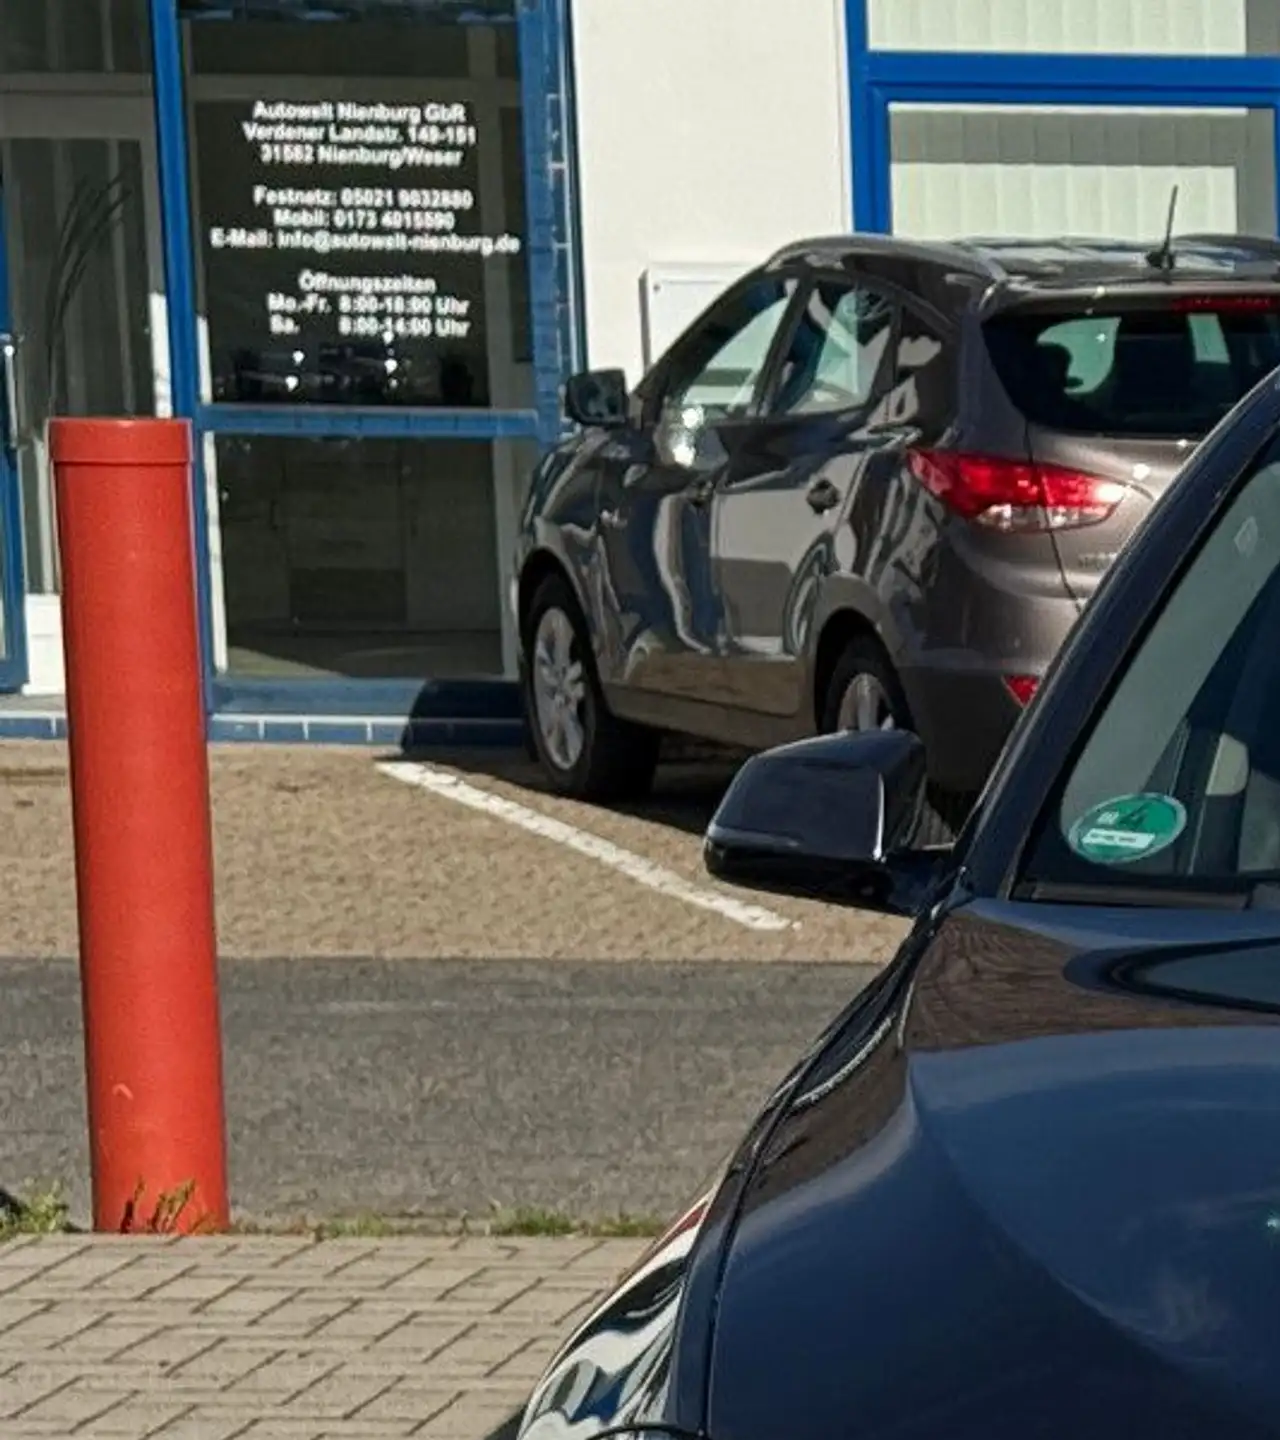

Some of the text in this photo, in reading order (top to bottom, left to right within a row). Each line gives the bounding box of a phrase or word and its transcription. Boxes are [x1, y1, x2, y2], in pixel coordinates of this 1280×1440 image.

[252, 101, 466, 124] Autowelt Nienburg GbR
[242, 121, 325, 141] Verdener
[328, 123, 404, 143] Landstr.
[317, 144, 463, 169] Nienburg/Weser
[253, 185, 337, 206] Festnetz:
[341, 187, 394, 207] 05021
[273, 210, 330, 229] Mobil:
[333, 209, 378, 229] 0173
[209, 228, 521, 257] E-Mail: info@autowelt-nienburg.de
[298, 269, 437, 293] Öffnungszeiten
[435, 295, 470, 315] Uhr
[435, 316, 471, 336] Uhr
